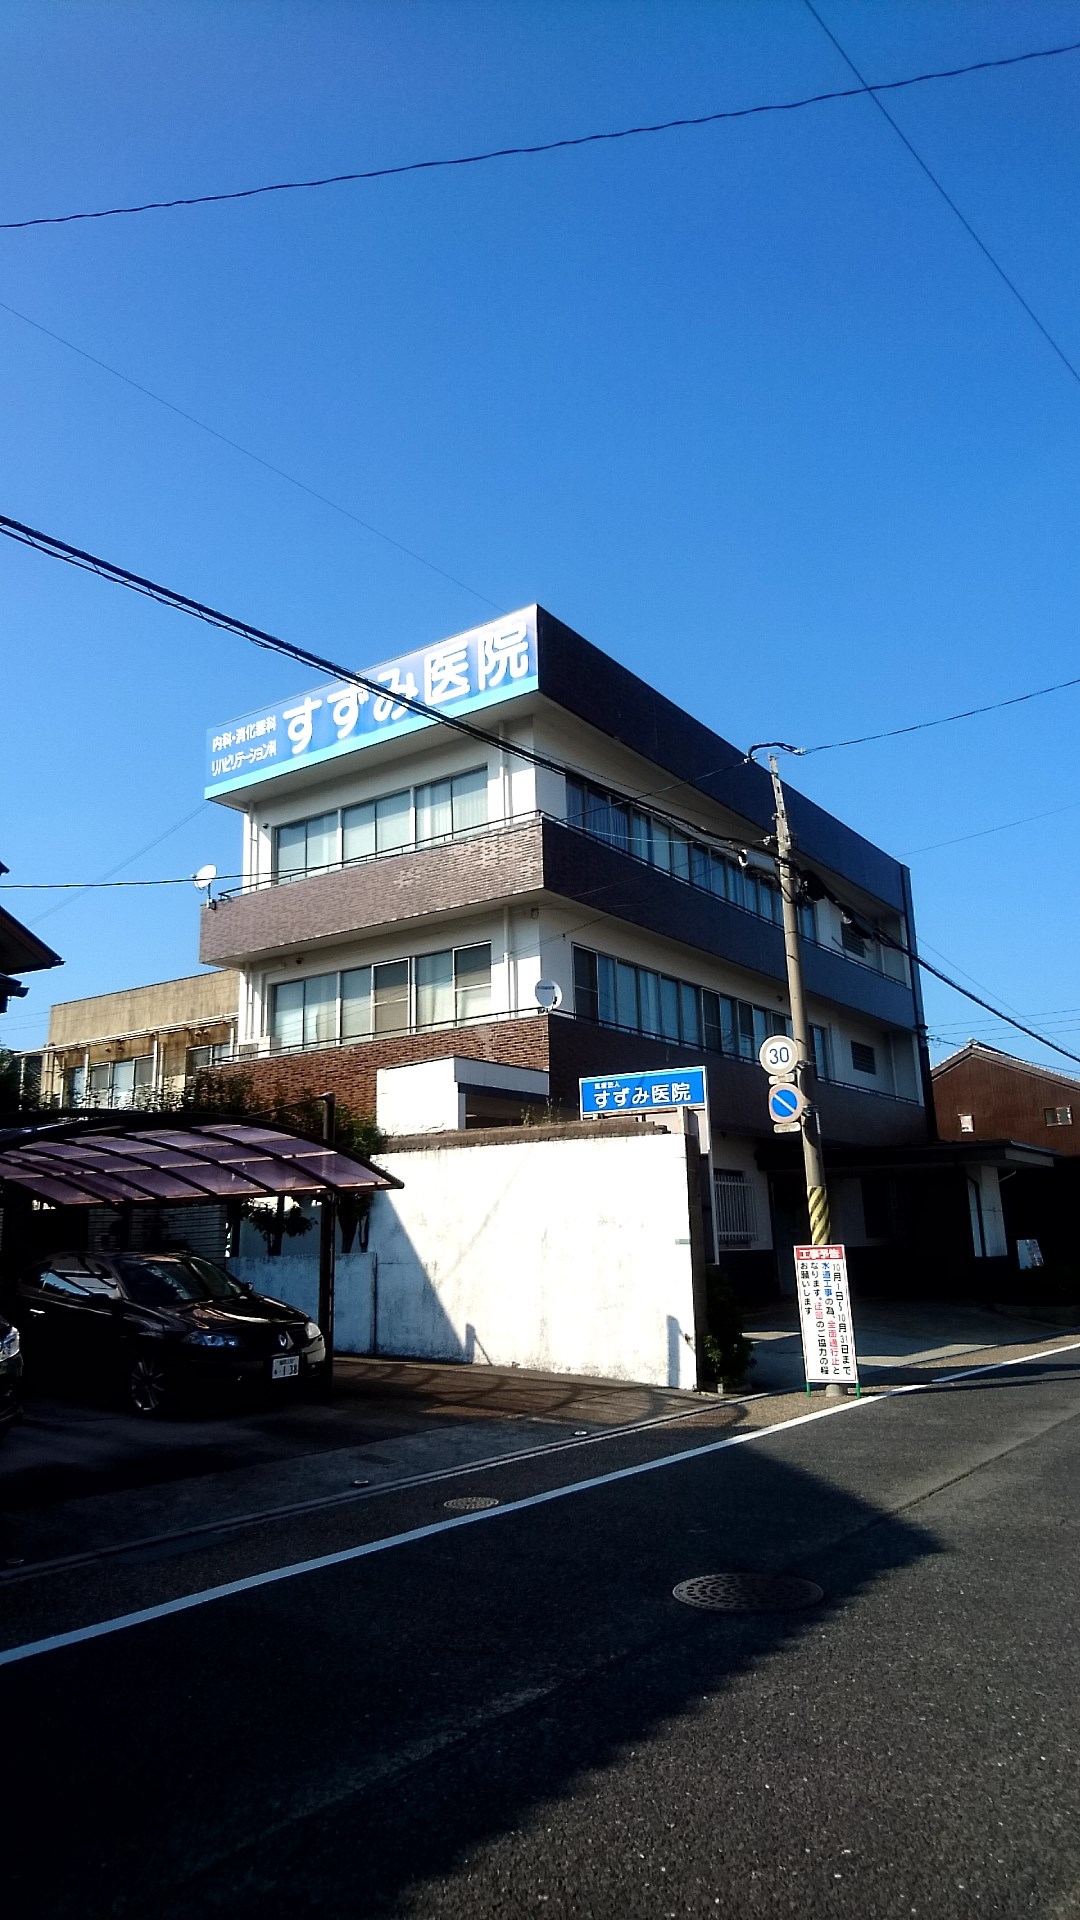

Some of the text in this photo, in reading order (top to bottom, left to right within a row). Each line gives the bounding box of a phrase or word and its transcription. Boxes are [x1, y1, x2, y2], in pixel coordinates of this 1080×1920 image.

[282, 619, 530, 755] すずみ医院
[769, 1046, 790, 1065] 30
[593, 1082, 692, 1109] すずみ医院
[798, 1248, 841, 1260] 工事予告
[800, 1262, 813, 1316] お願いします
